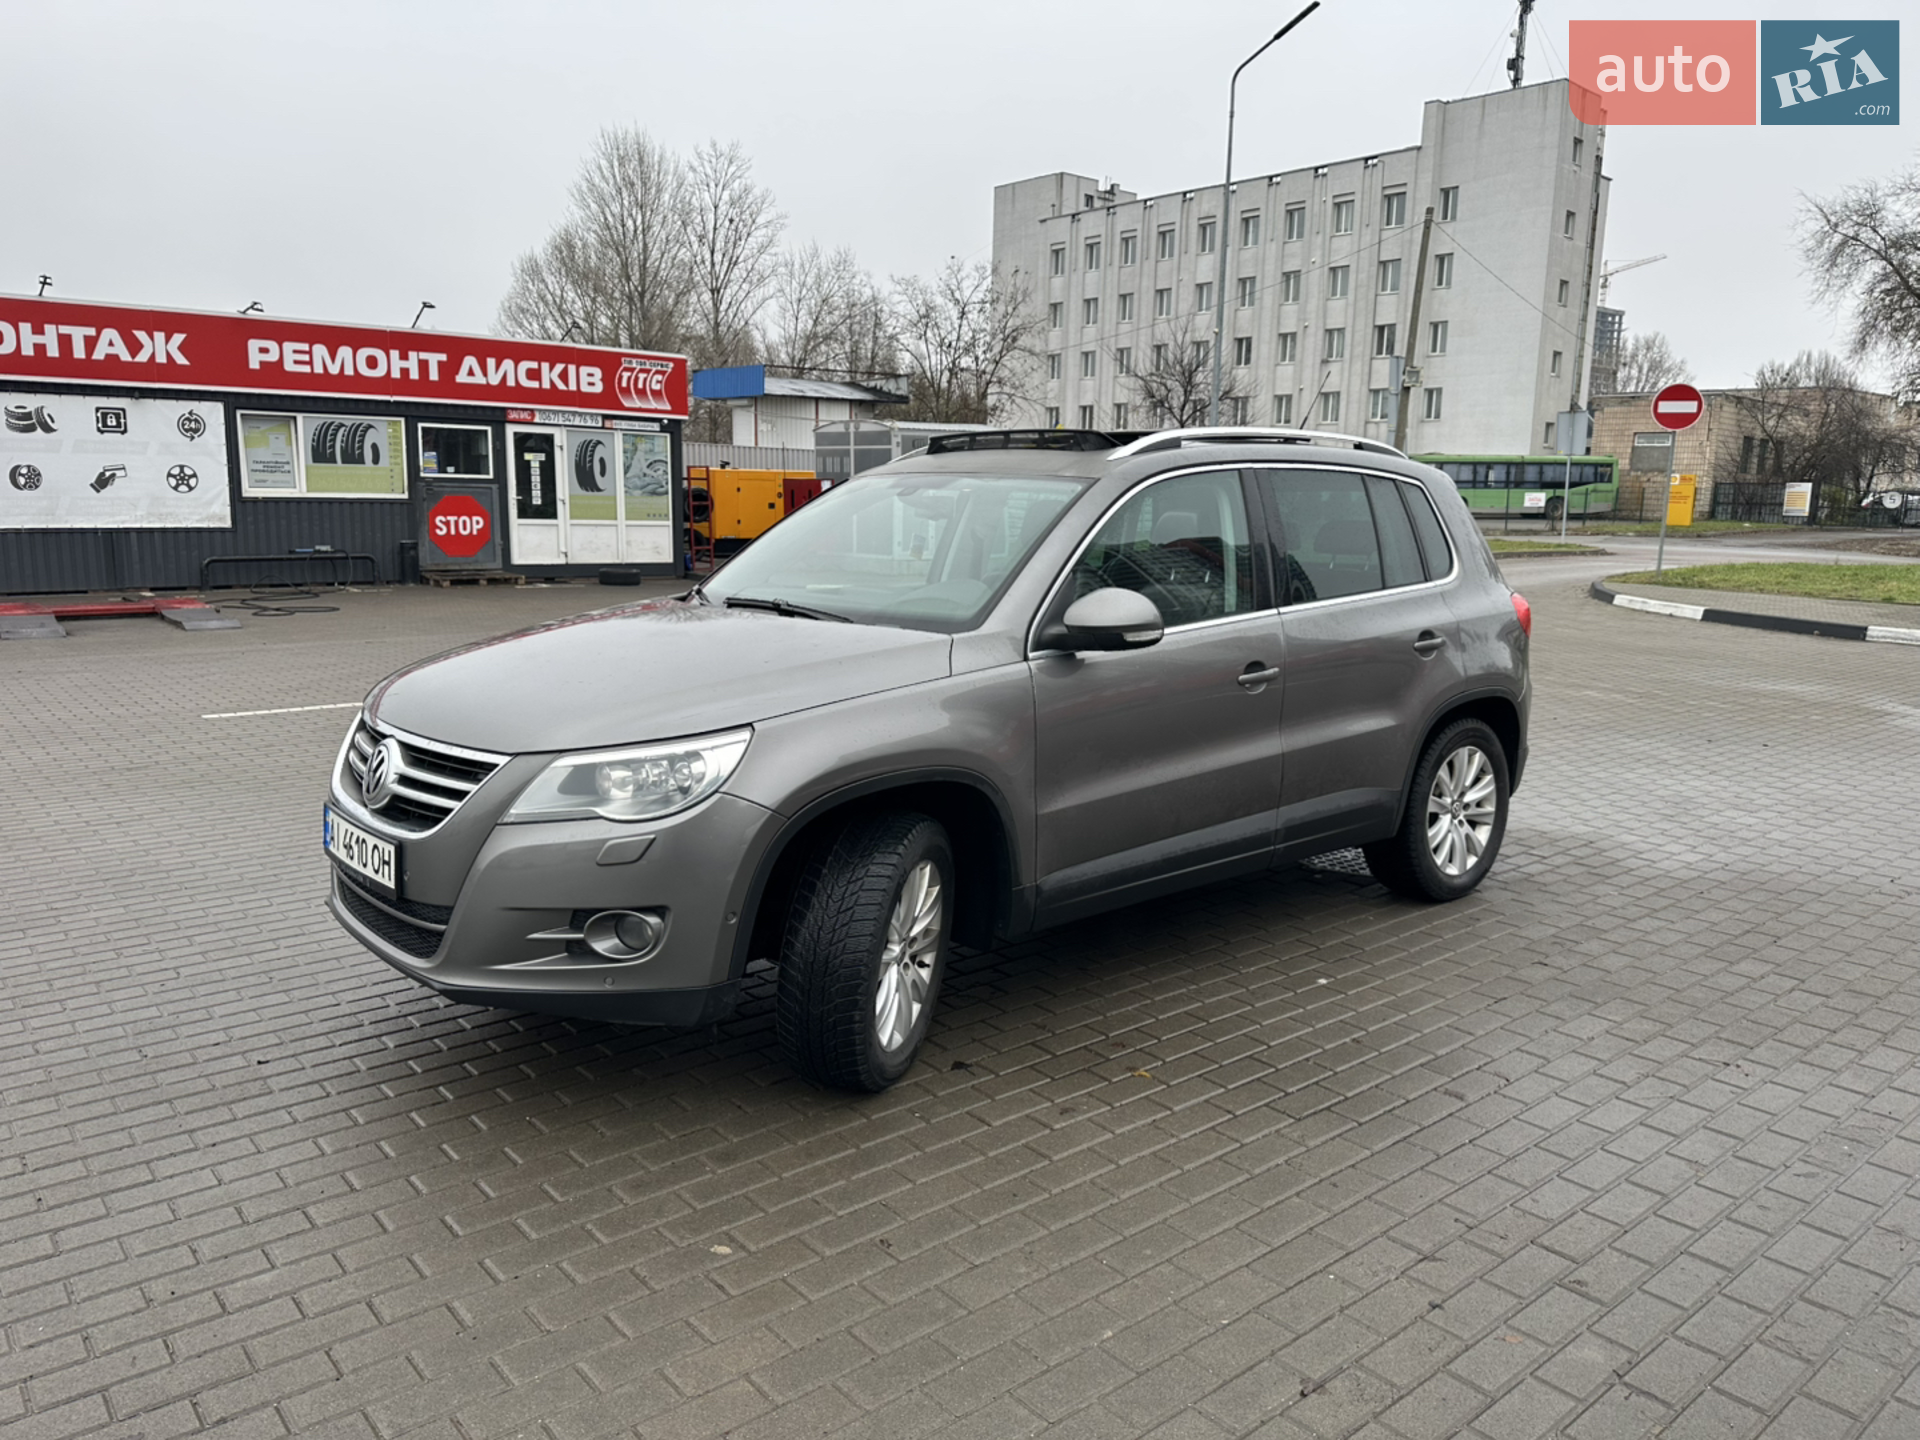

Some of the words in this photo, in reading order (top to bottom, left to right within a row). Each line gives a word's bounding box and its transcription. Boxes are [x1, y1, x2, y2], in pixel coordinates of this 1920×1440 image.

[247, 338, 448, 382] РЕМОНТ
[455, 355, 604, 394] ДИСКІВ
[507, 409, 532, 420] ЗАПИС
[435, 515, 484, 536] STOP
[343, 828, 368, 869] 4610
[371, 843, 392, 882] OH
